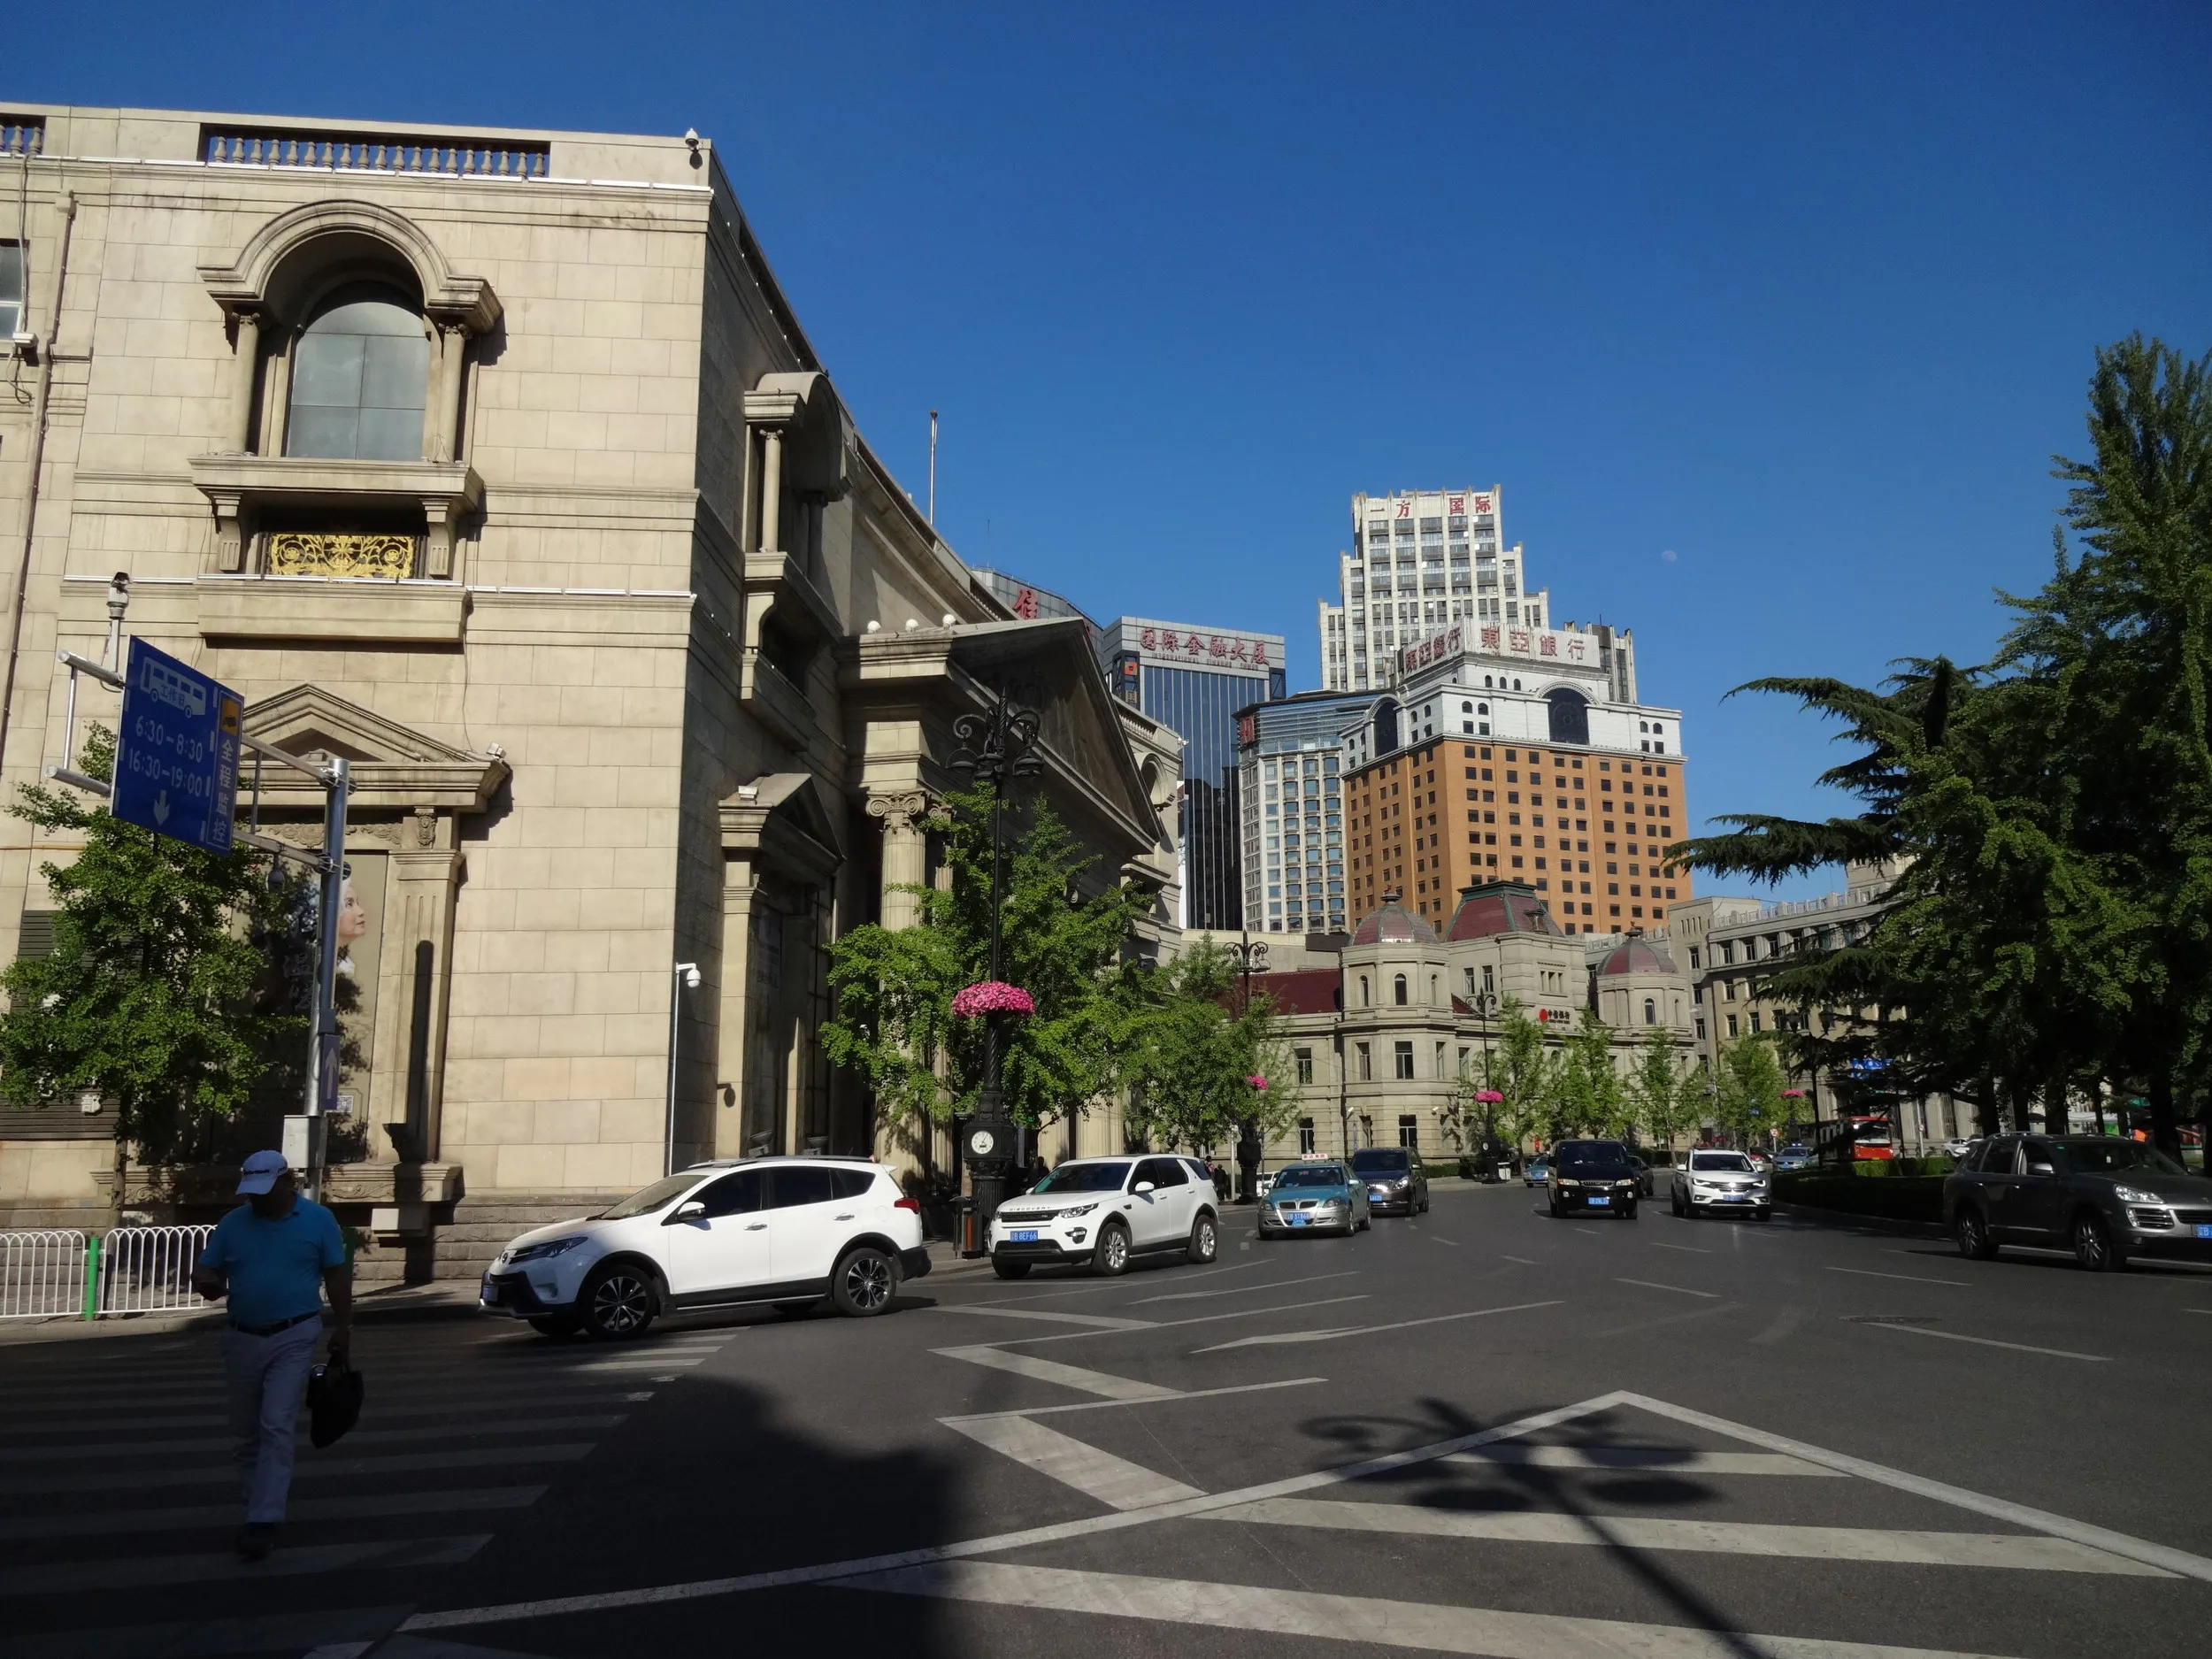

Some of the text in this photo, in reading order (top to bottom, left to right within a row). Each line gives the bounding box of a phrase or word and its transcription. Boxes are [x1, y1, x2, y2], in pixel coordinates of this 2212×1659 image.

[1141, 626, 1270, 665] 国际金融大厦
[212, 739, 234, 842] 全程监控
